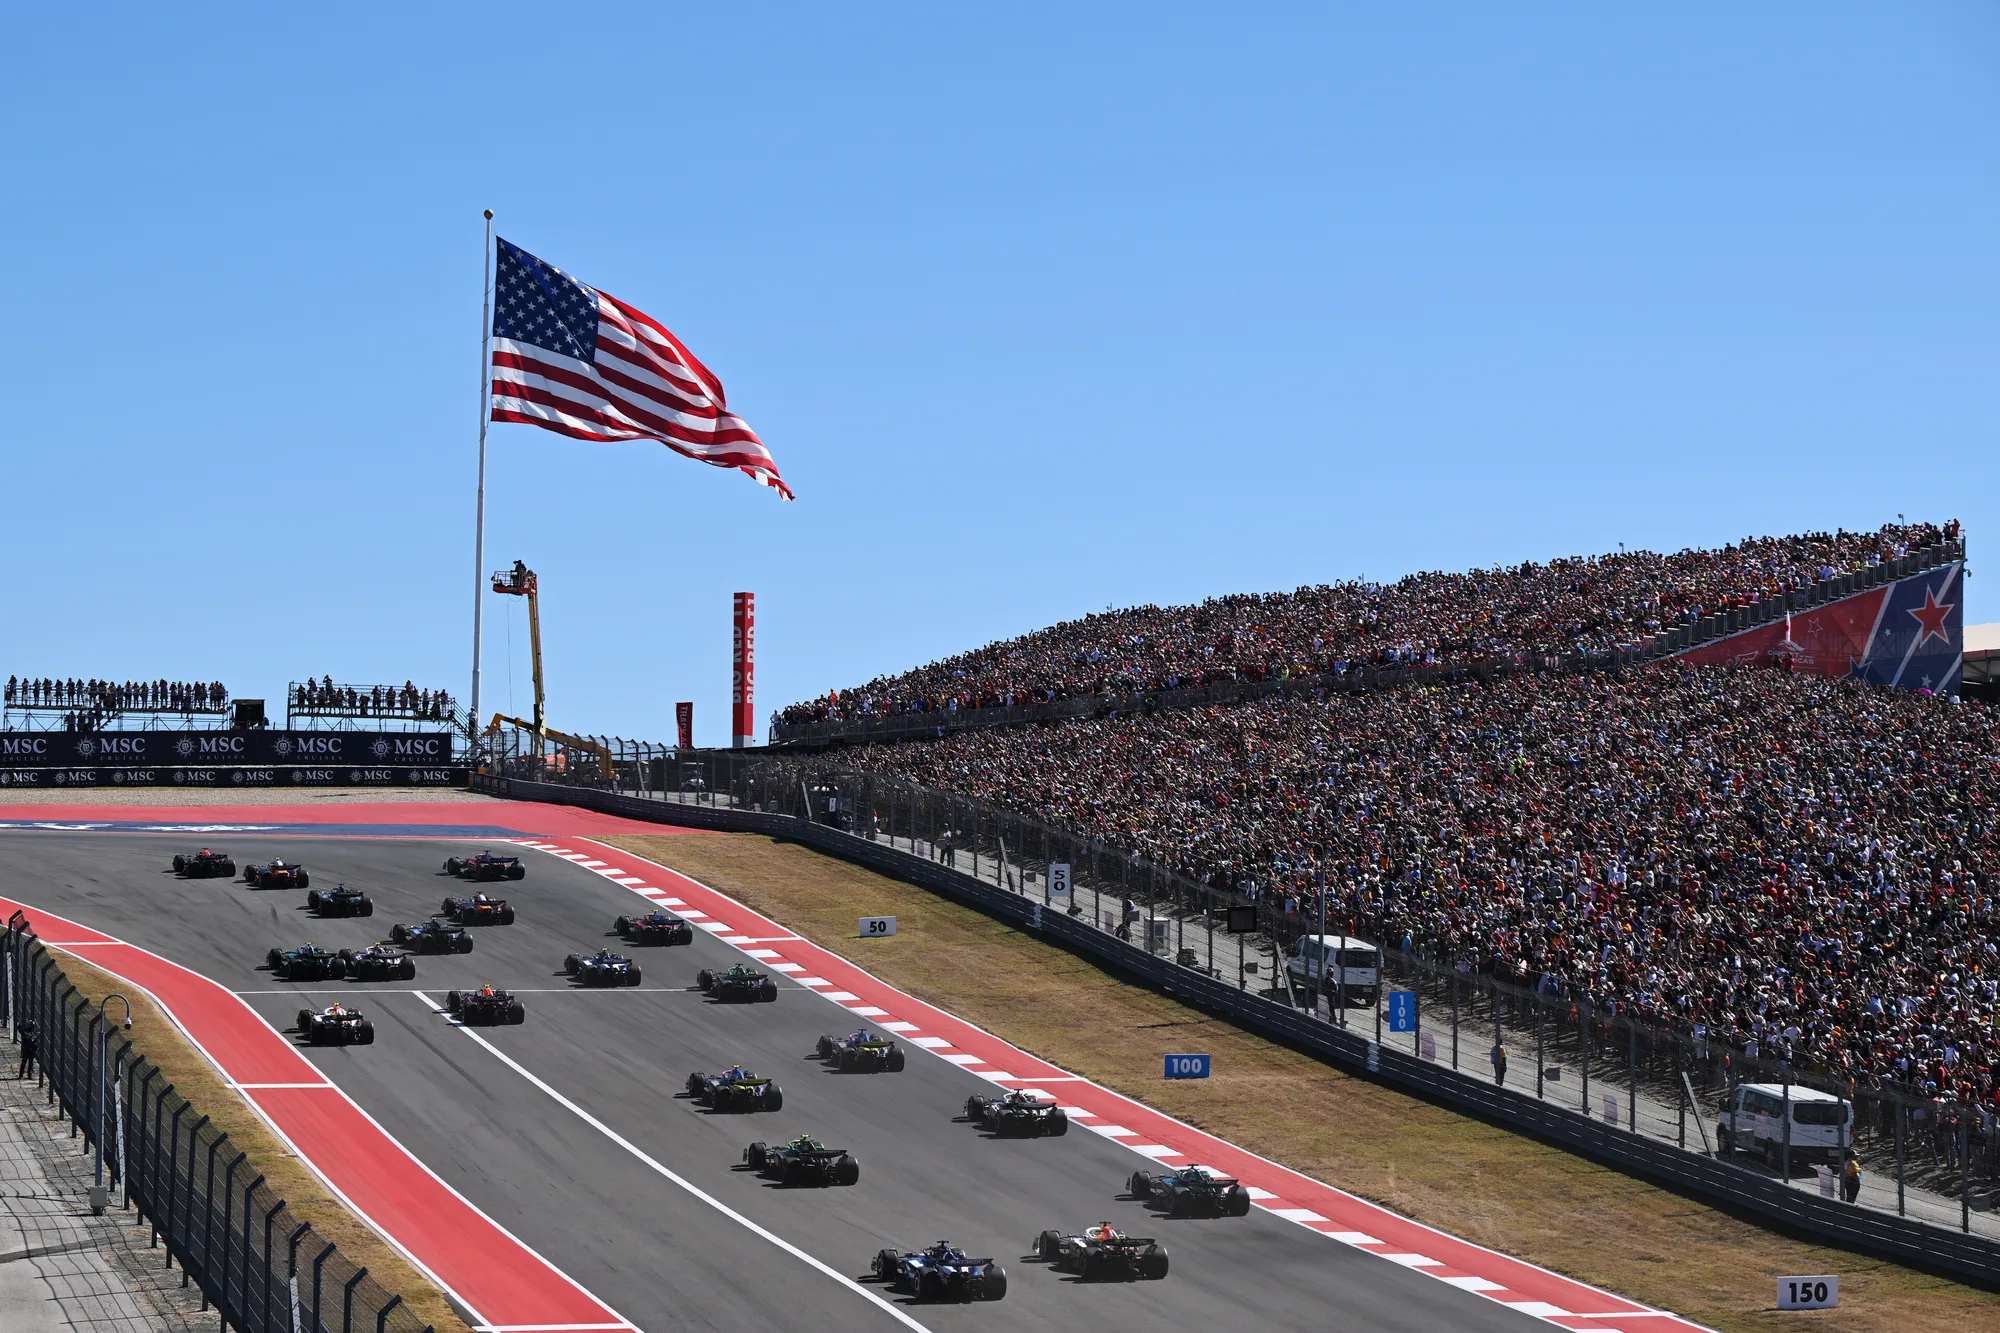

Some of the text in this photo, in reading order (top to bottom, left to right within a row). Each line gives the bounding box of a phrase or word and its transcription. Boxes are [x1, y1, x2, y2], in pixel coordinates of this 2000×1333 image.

[679, 705, 688, 735] TRACK
[3, 738, 46, 754] MSC
[100, 738, 146, 753] MSC
[199, 737, 245, 752] MSC
[297, 737, 342, 753] MSC
[394, 739, 439, 755] MSC
[13, 772, 38, 782] MSC
[68, 771, 96, 781] MSC
[127, 771, 155, 781] MSC
[187, 771, 216, 781] MSC
[246, 771, 274, 781] MSC
[306, 770, 334, 780] MSC
[364, 770, 392, 780] MSC
[423, 770, 450, 781] MSC
[1053, 869, 1066, 891] 50
[869, 920, 887, 933] 50
[1398, 994, 1406, 1029] 100
[1172, 1058, 1202, 1074] 100
[1789, 1281, 1828, 1303] 150
